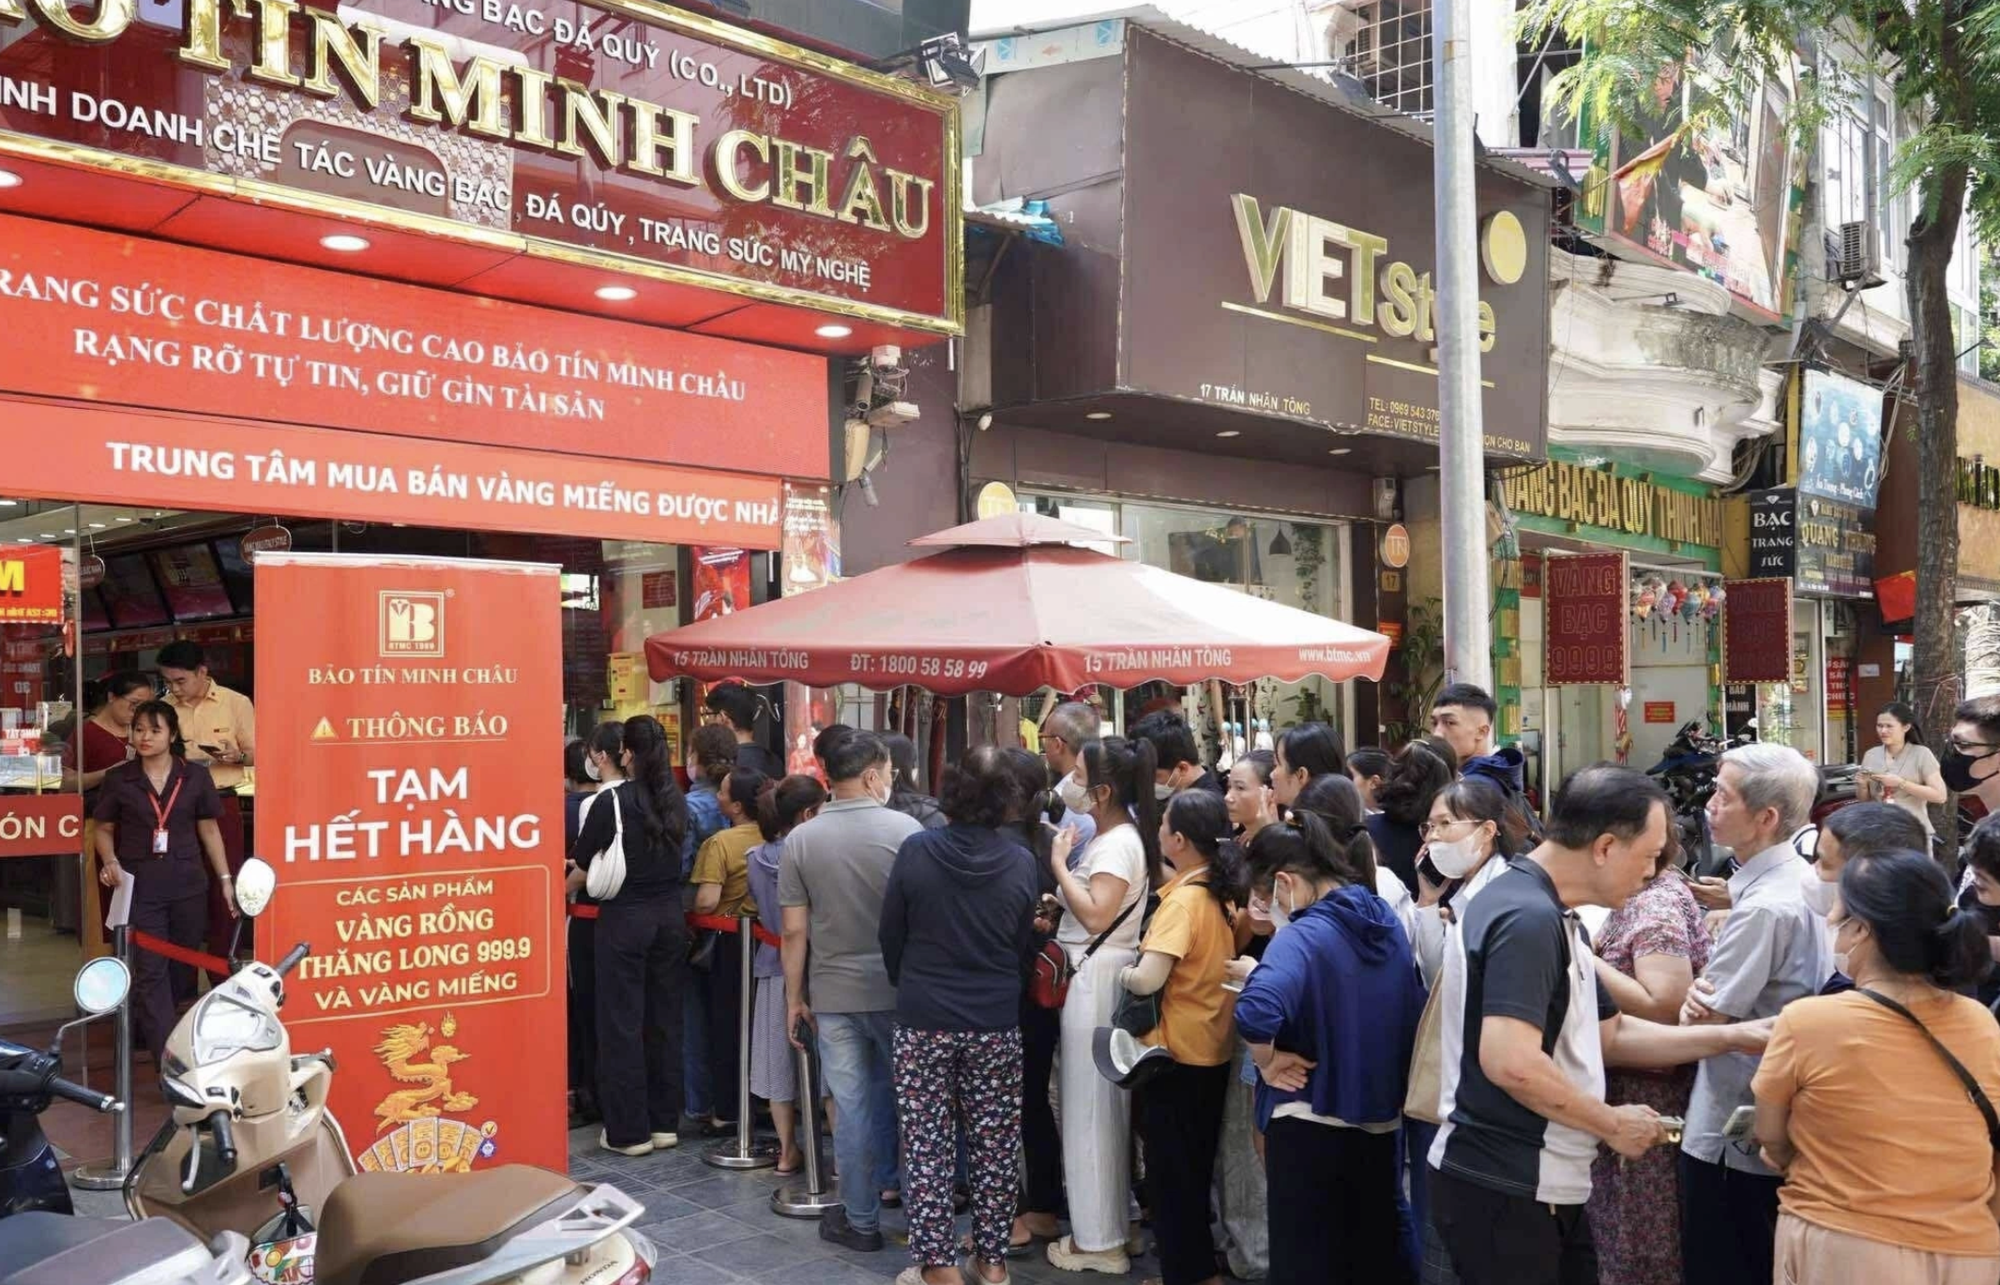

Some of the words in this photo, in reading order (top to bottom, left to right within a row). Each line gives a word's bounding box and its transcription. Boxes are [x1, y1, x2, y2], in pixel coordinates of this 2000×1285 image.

[482, 0, 544, 35] BẠC
[553, 18, 595, 51] ĐÁ
[602, 33, 661, 69] QUÝ
[669, 49, 732, 99] (CO.,
[741, 69, 793, 110] LTD)
[408, 36, 702, 187] MINH
[711, 129, 937, 239] CHÂU
[72, 92, 204, 147] DOANH
[293, 139, 357, 178] TÁC
[366, 157, 447, 198] VÀNG
[526, 192, 565, 225] ĐÁ
[639, 218, 721, 256] TRANG
[728, 238, 775, 268] SỨC
[781, 245, 815, 276] MỸ
[816, 258, 873, 295] NGHỆ
[109, 283, 186, 321] SỨC
[193, 301, 292, 337] CHẤT
[300, 317, 415, 354] LƯỢNG
[421, 333, 485, 364] CAO
[491, 342, 550, 374] BẢO
[554, 347, 600, 381] TÍN
[607, 361, 674, 392] MINH
[680, 370, 746, 402] CHÂU
[74, 328, 181, 368] RẠNG
[191, 342, 245, 375] RỠ
[250, 352, 301, 388] TỰ
[306, 360, 370, 396] TIN,
[377, 370, 437, 400] GIỮ
[442, 378, 494, 408] GÌN
[500, 384, 546, 414] TÀI
[553, 390, 605, 421] SẢN
[1200, 383, 1212, 398] 17
[106, 441, 234, 481] TRUNG
[244, 449, 316, 487] TÂM
[327, 461, 398, 494] MUA
[407, 464, 469, 500] BÁN
[476, 471, 555, 507] VÀNG
[563, 481, 650, 516] MIẾNG
[657, 492, 728, 526] ĐƯỢC
[1753, 511, 1791, 531] BẠC
[1801, 521, 1839, 548] QUANG
[1752, 536, 1793, 548] TRANG
[1386, 575, 1397, 588] 17
[308, 664, 354, 685] BẢO
[360, 663, 395, 685] TÍN
[402, 667, 457, 685] MINH
[463, 664, 518, 685] CHÂU
[729, 647, 767, 668] NHÂN
[771, 647, 809, 669] TÔNG
[851, 655, 875, 673] ĐT:
[881, 655, 916, 675] 1800
[921, 656, 940, 676] 58
[944, 658, 964, 678] 58
[968, 660, 987, 679] 99
[1084, 654, 1102, 673] 15
[1195, 645, 1232, 668] TÔNG
[1299, 645, 1371, 664] www.btmc.vn
[1552, 646, 1617, 676] 9999
[347, 711, 445, 739] THÔNG
[454, 709, 508, 737] BÁO
[367, 766, 468, 812] TẠM
[58, 814, 80, 838] C
[284, 809, 389, 863] HẾT
[399, 809, 541, 857] HÀNG
[336, 885, 380, 907] CÁC
[386, 881, 427, 902] SẢN
[433, 876, 494, 899] PHẨM
[335, 912, 412, 944] VÀNG
[419, 902, 494, 937] RỒNG
[298, 947, 392, 981] THĂNG
[399, 942, 470, 972] LONG
[477, 936, 531, 964] 999.9
[314, 986, 353, 1012] VÀ
[358, 981, 430, 1008] VÀNG
[438, 969, 518, 998] MIẾNG
[580, 1261, 619, 1285] HONDA
